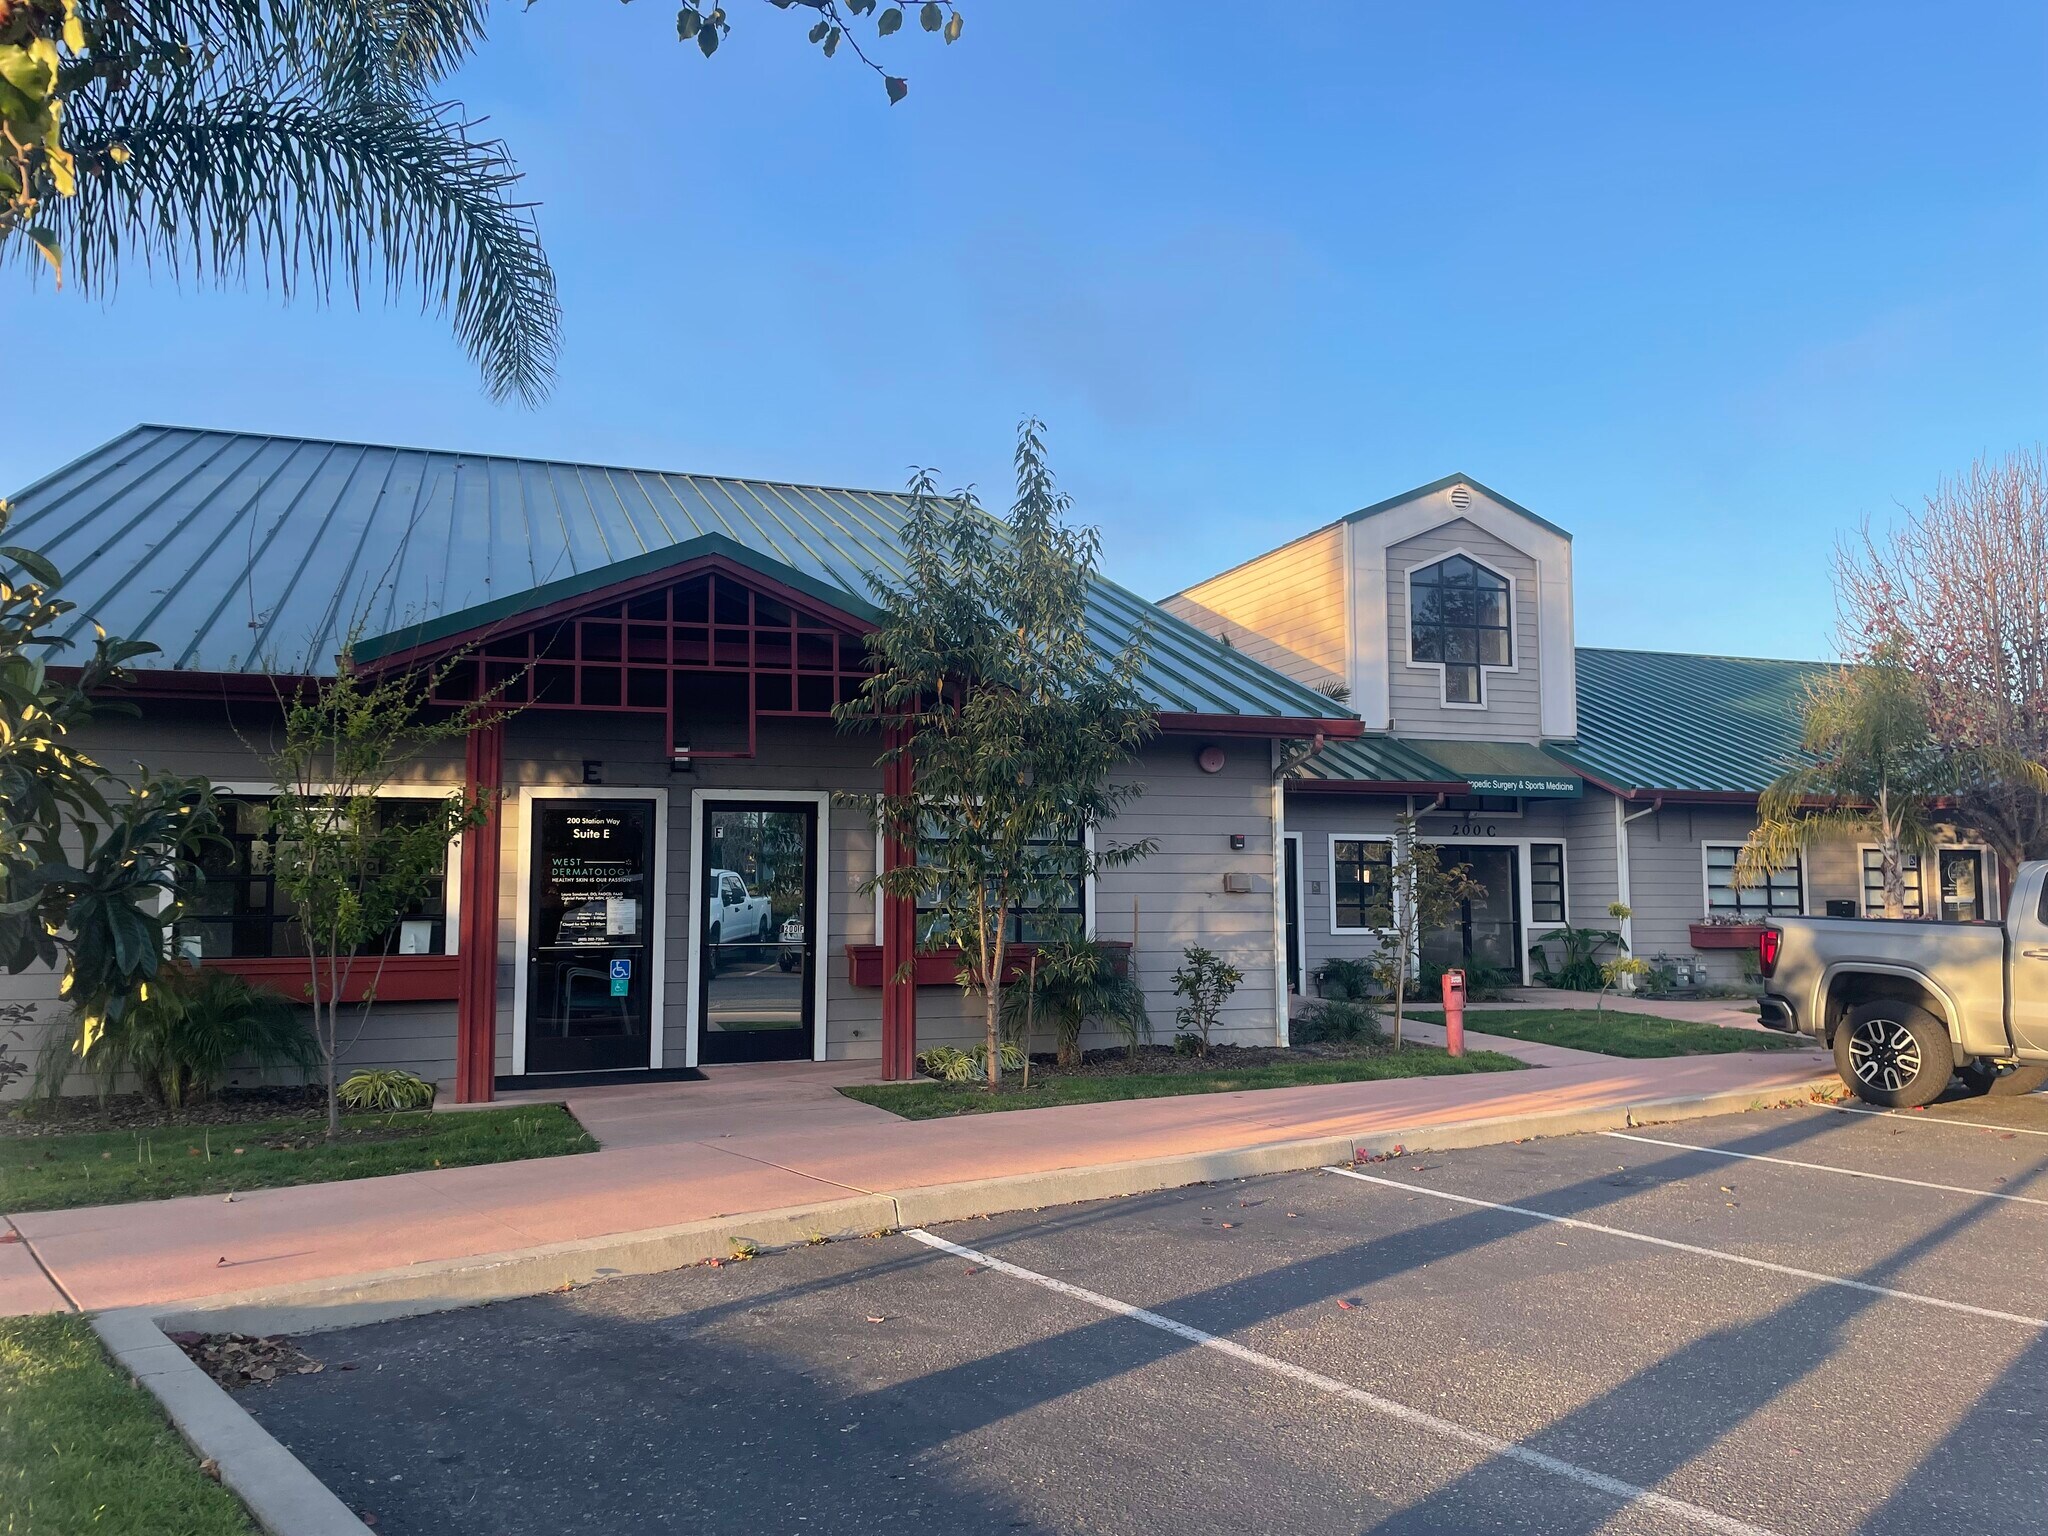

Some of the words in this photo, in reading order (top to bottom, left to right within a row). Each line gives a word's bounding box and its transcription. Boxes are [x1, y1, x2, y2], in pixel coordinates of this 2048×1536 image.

[582, 760, 602, 784] E
[1492, 780, 1518, 791] Surgery
[1518, 780, 1524, 789] &
[1525, 781, 1545, 791] Sports
[1546, 781, 1574, 791] Medicine
[581, 817, 605, 825] Station
[573, 828, 600, 839] Suite
[603, 829, 610, 839] E
[716, 827, 723, 838] F
[1452, 824, 1481, 836] 200
[1486, 825, 1496, 837] C
[552, 858, 581, 866] WEST
[552, 867, 632, 876] DERMATOLOGY
[784, 925, 798, 933] 200
